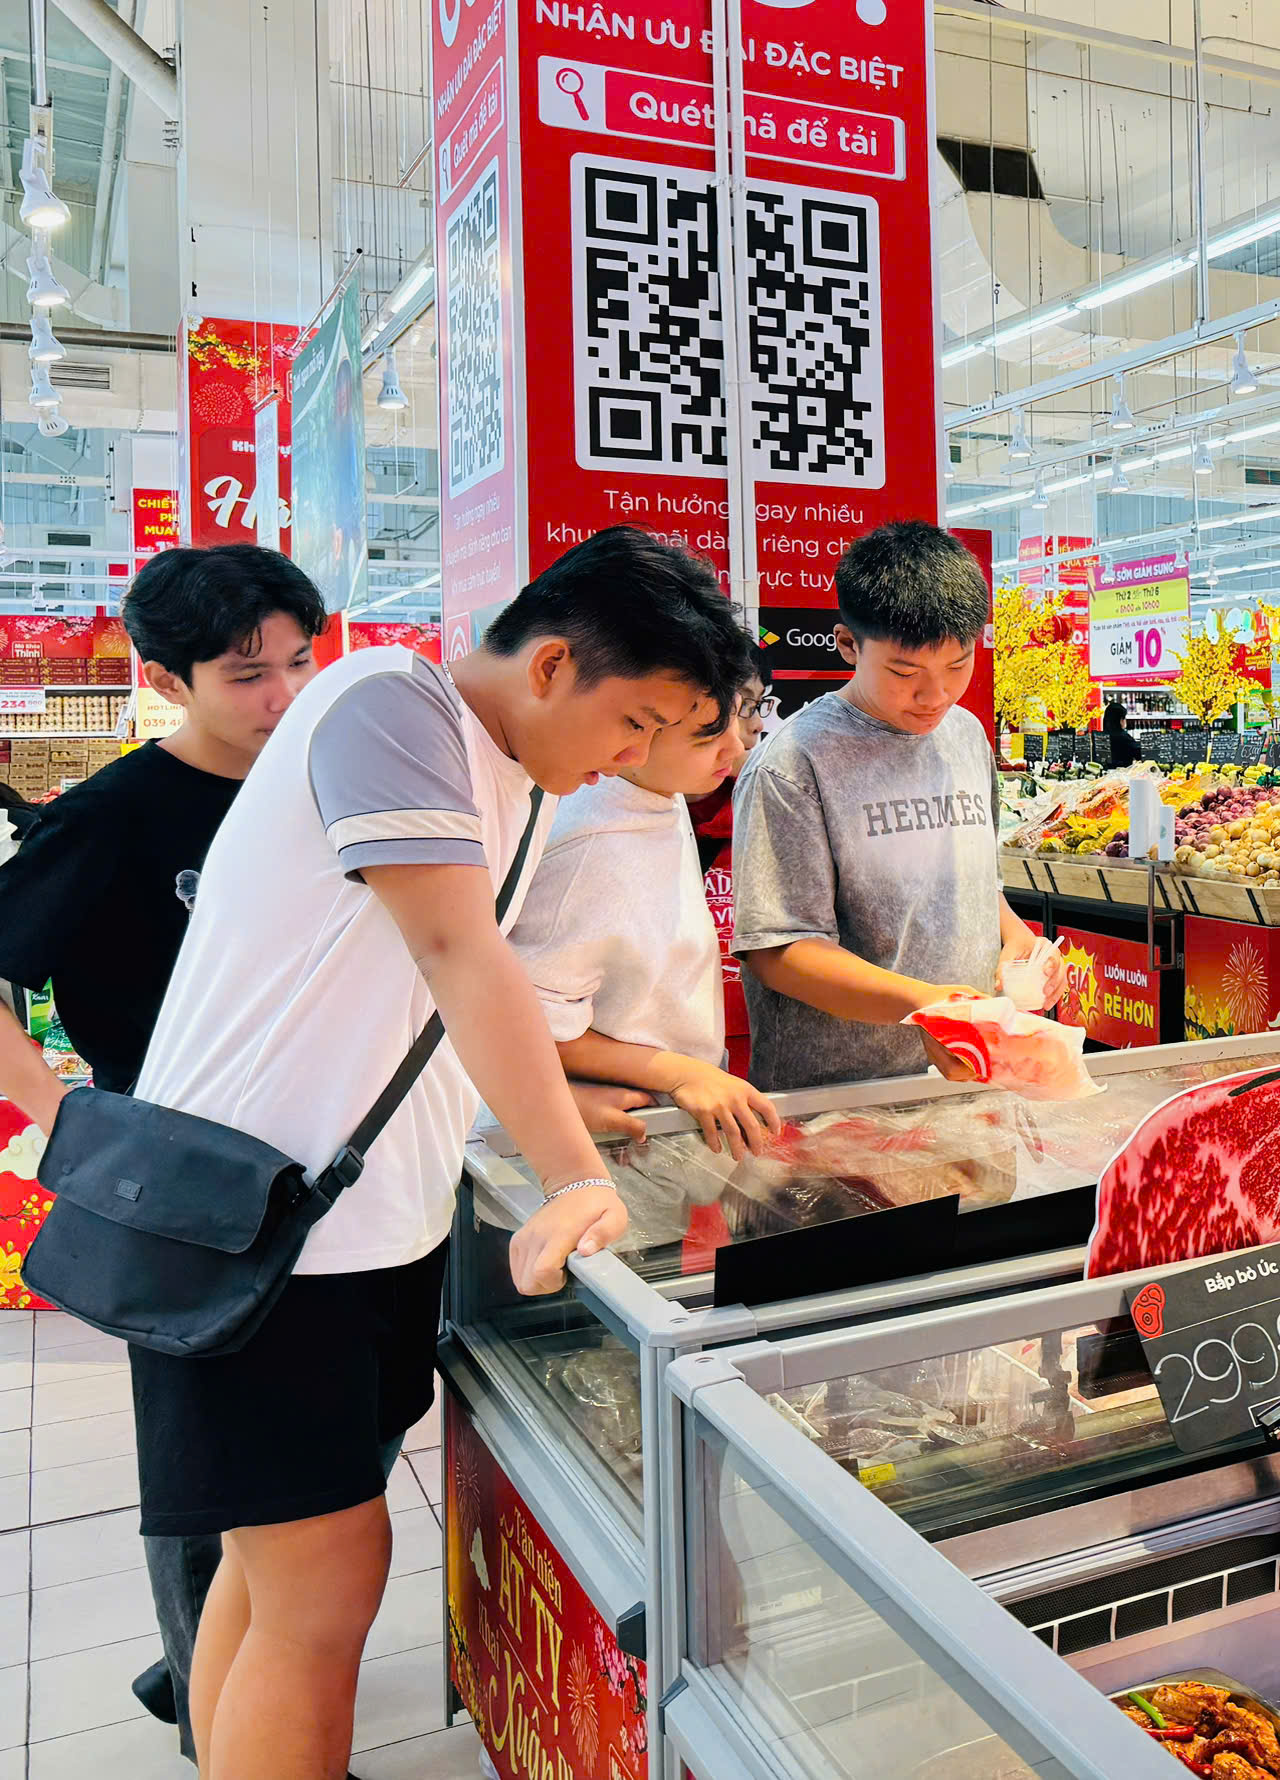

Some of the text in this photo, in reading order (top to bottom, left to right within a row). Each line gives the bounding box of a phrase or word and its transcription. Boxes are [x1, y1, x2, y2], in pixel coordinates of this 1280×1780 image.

[536, 0, 904, 90] NHẬN ƯU ĐI ĐẶC BIỆT
[629, 91, 715, 129] Quét
[787, 116, 828, 148] để
[838, 125, 878, 157] tải
[604, 489, 864, 524] Tận hưởng gay nhiều
[763, 535, 819, 558] riêng
[760, 567, 836, 591] rực tuy
[1111, 637, 1132, 655] GIẢM
[1104, 963, 1148, 988] LUÔN LUÔN
[1104, 986, 1154, 1029] RẺ HƠN
[1204, 1259, 1279, 1293] Bắp bò Úc
[514, 1506, 563, 1615] Tân niên
[479, 1597, 500, 1672] Khai
